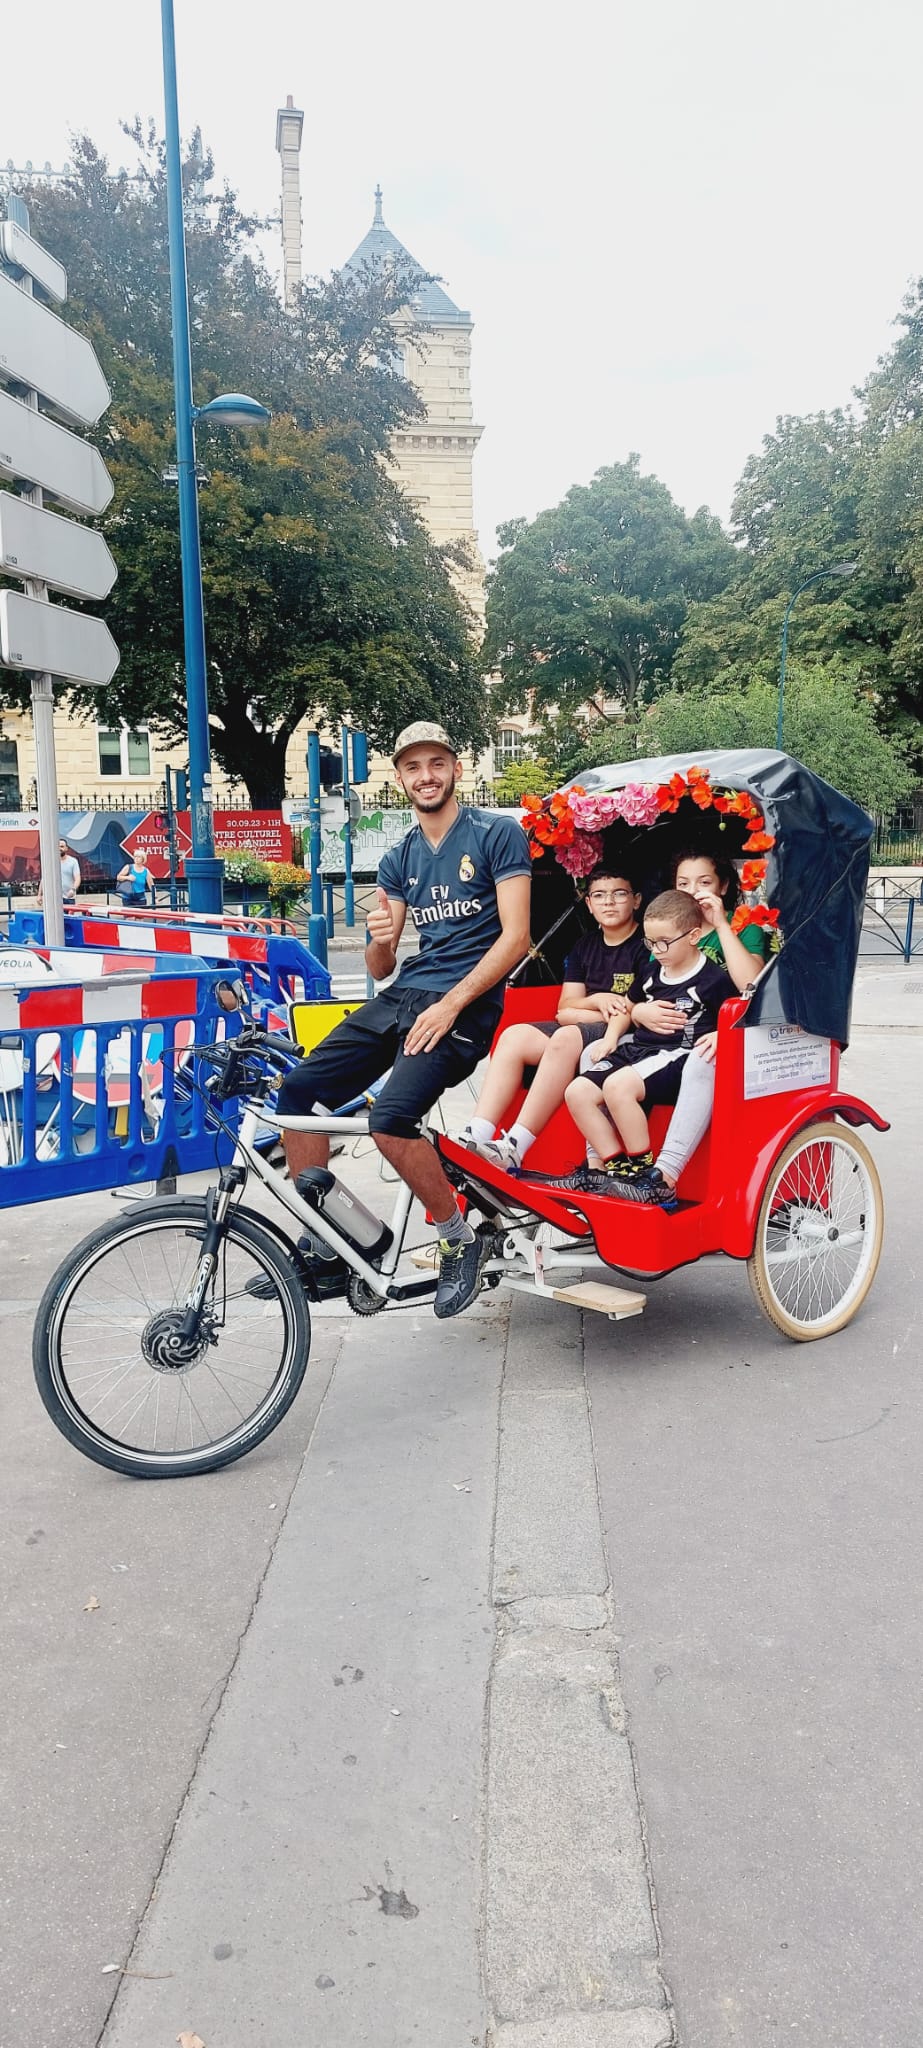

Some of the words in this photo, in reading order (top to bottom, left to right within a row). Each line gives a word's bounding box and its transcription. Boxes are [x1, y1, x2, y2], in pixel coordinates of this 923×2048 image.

[214, 830, 236, 839] NTRE
[237, 829, 282, 839] CULTUREL
[239, 839, 283, 848] MANDELA
[431, 885, 449, 899] Fly
[411, 898, 482, 926] Emirates
